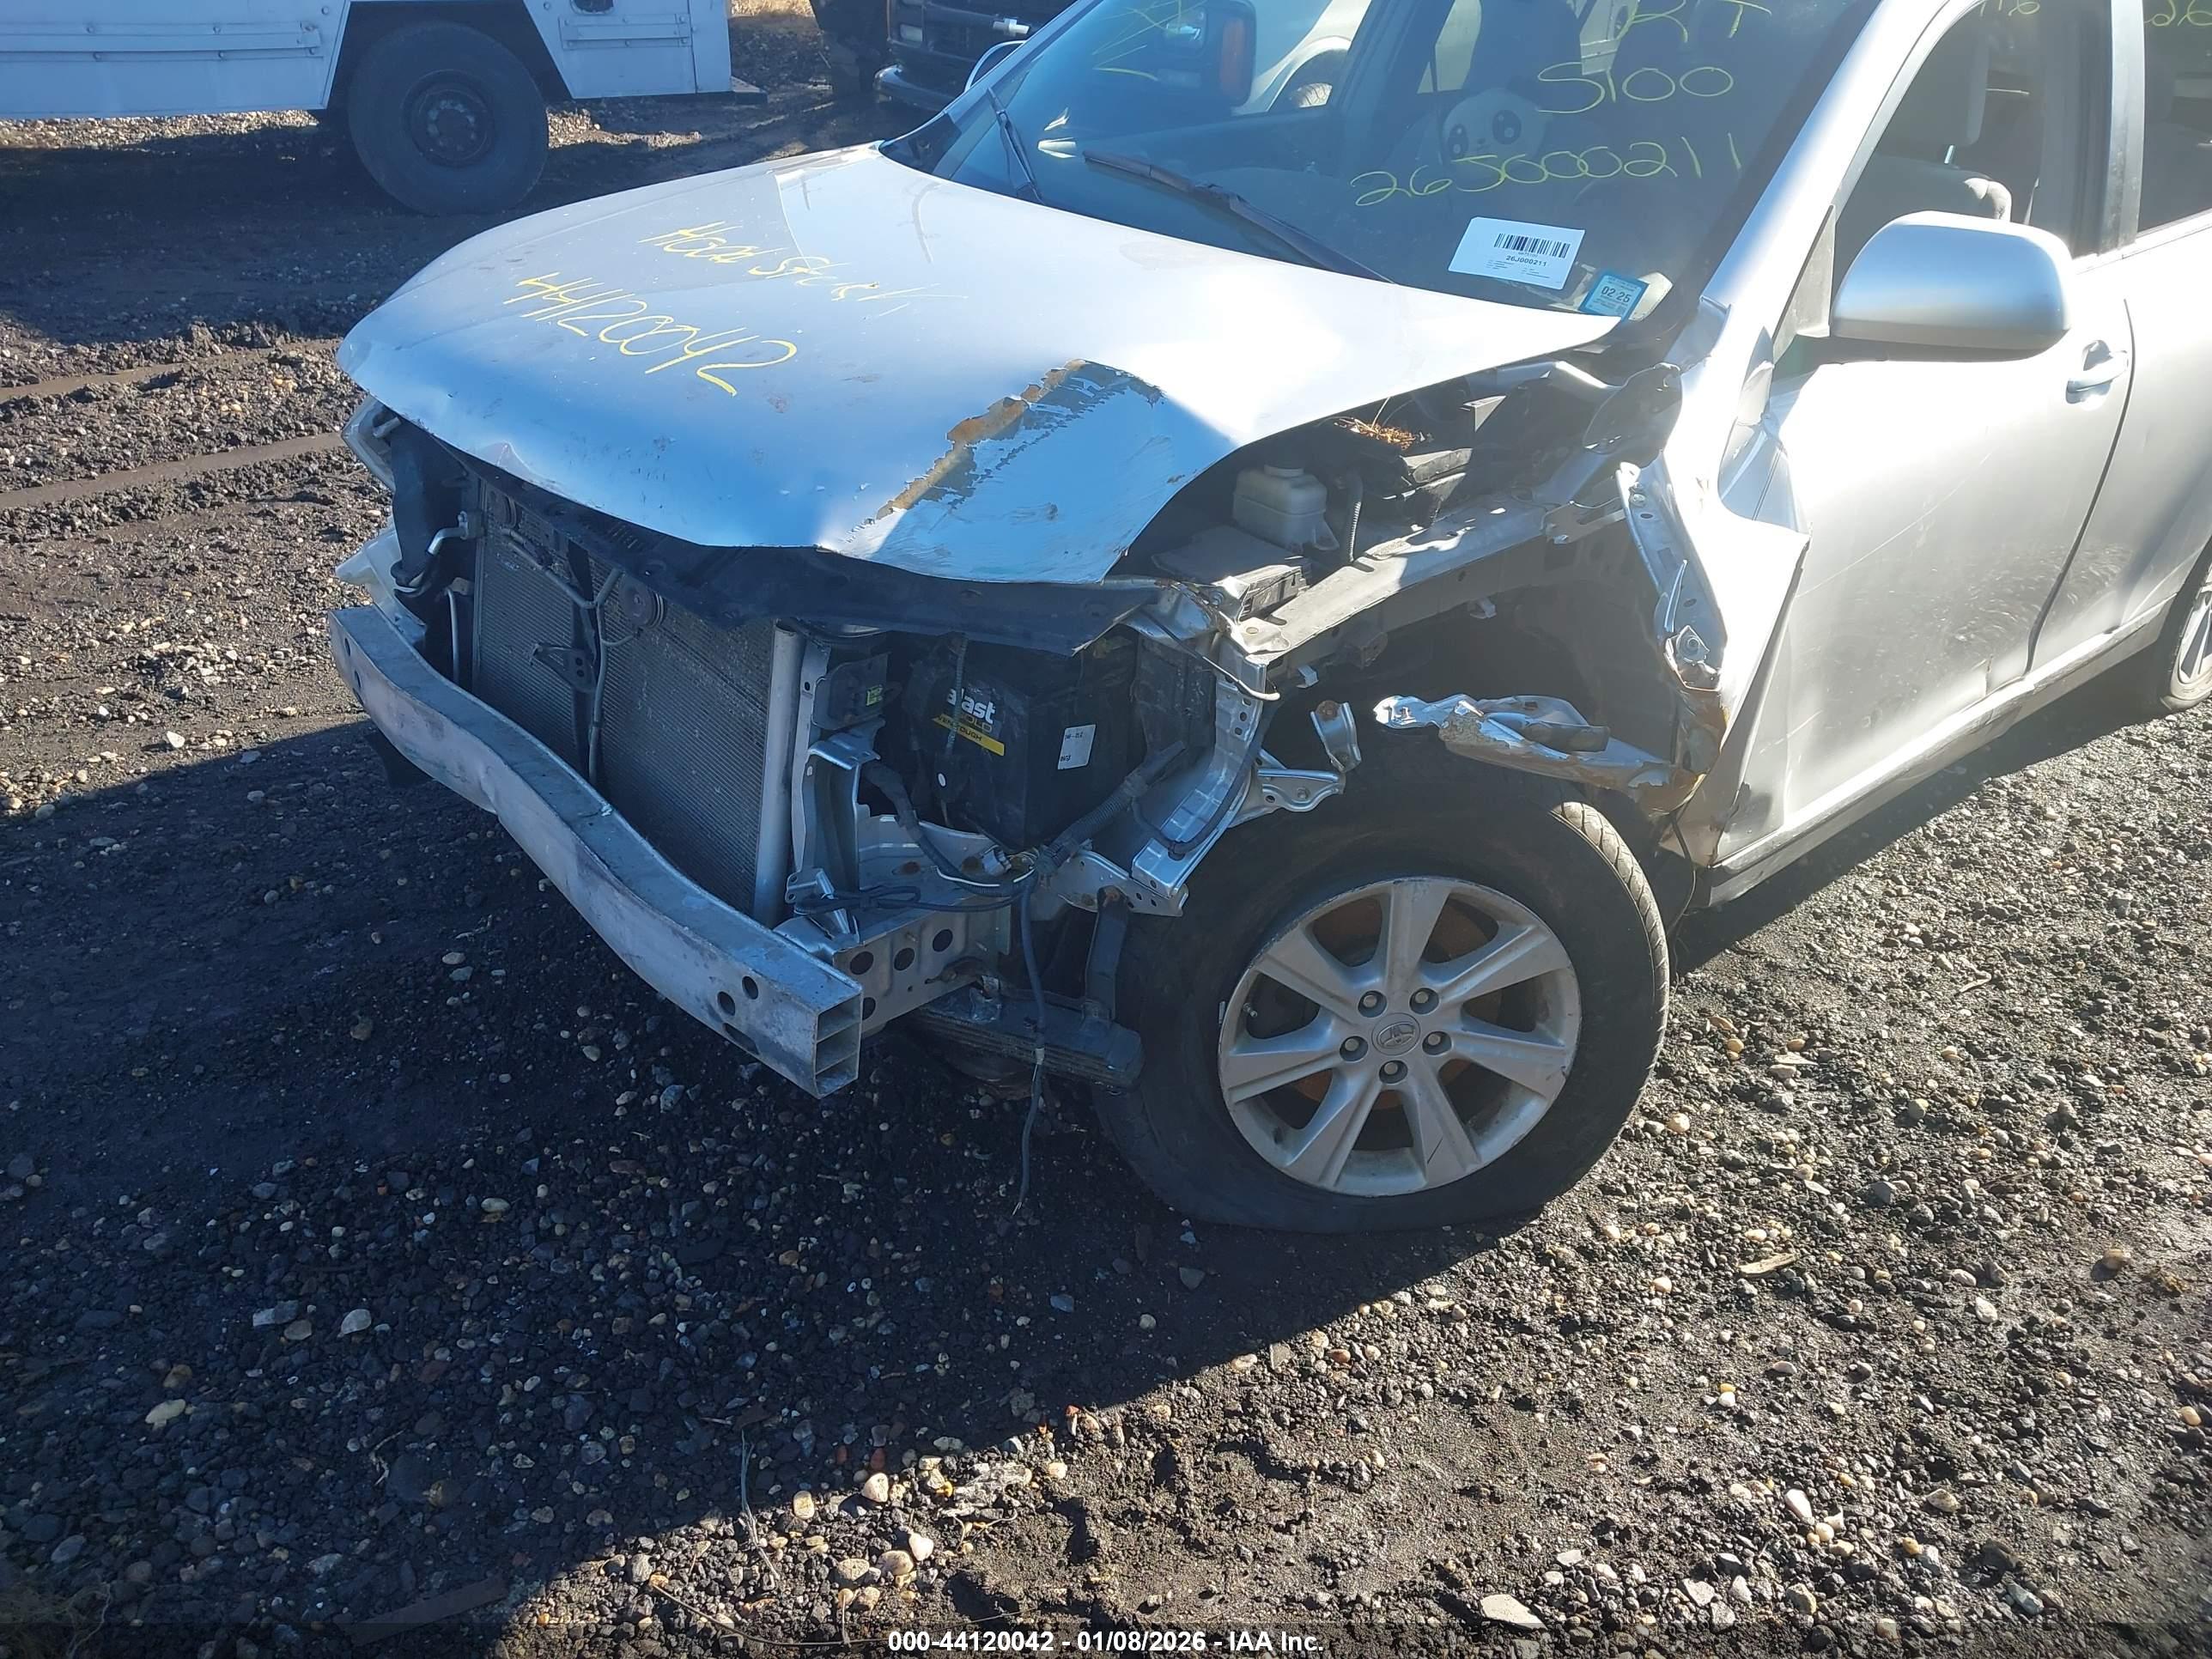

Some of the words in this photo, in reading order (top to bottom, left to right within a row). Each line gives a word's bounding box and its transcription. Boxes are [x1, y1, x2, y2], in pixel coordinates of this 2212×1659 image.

[1505, 255, 1548, 267] 26J000211
[1601, 286, 1616, 298] 02
[502, 271, 799, 397] 44120042
